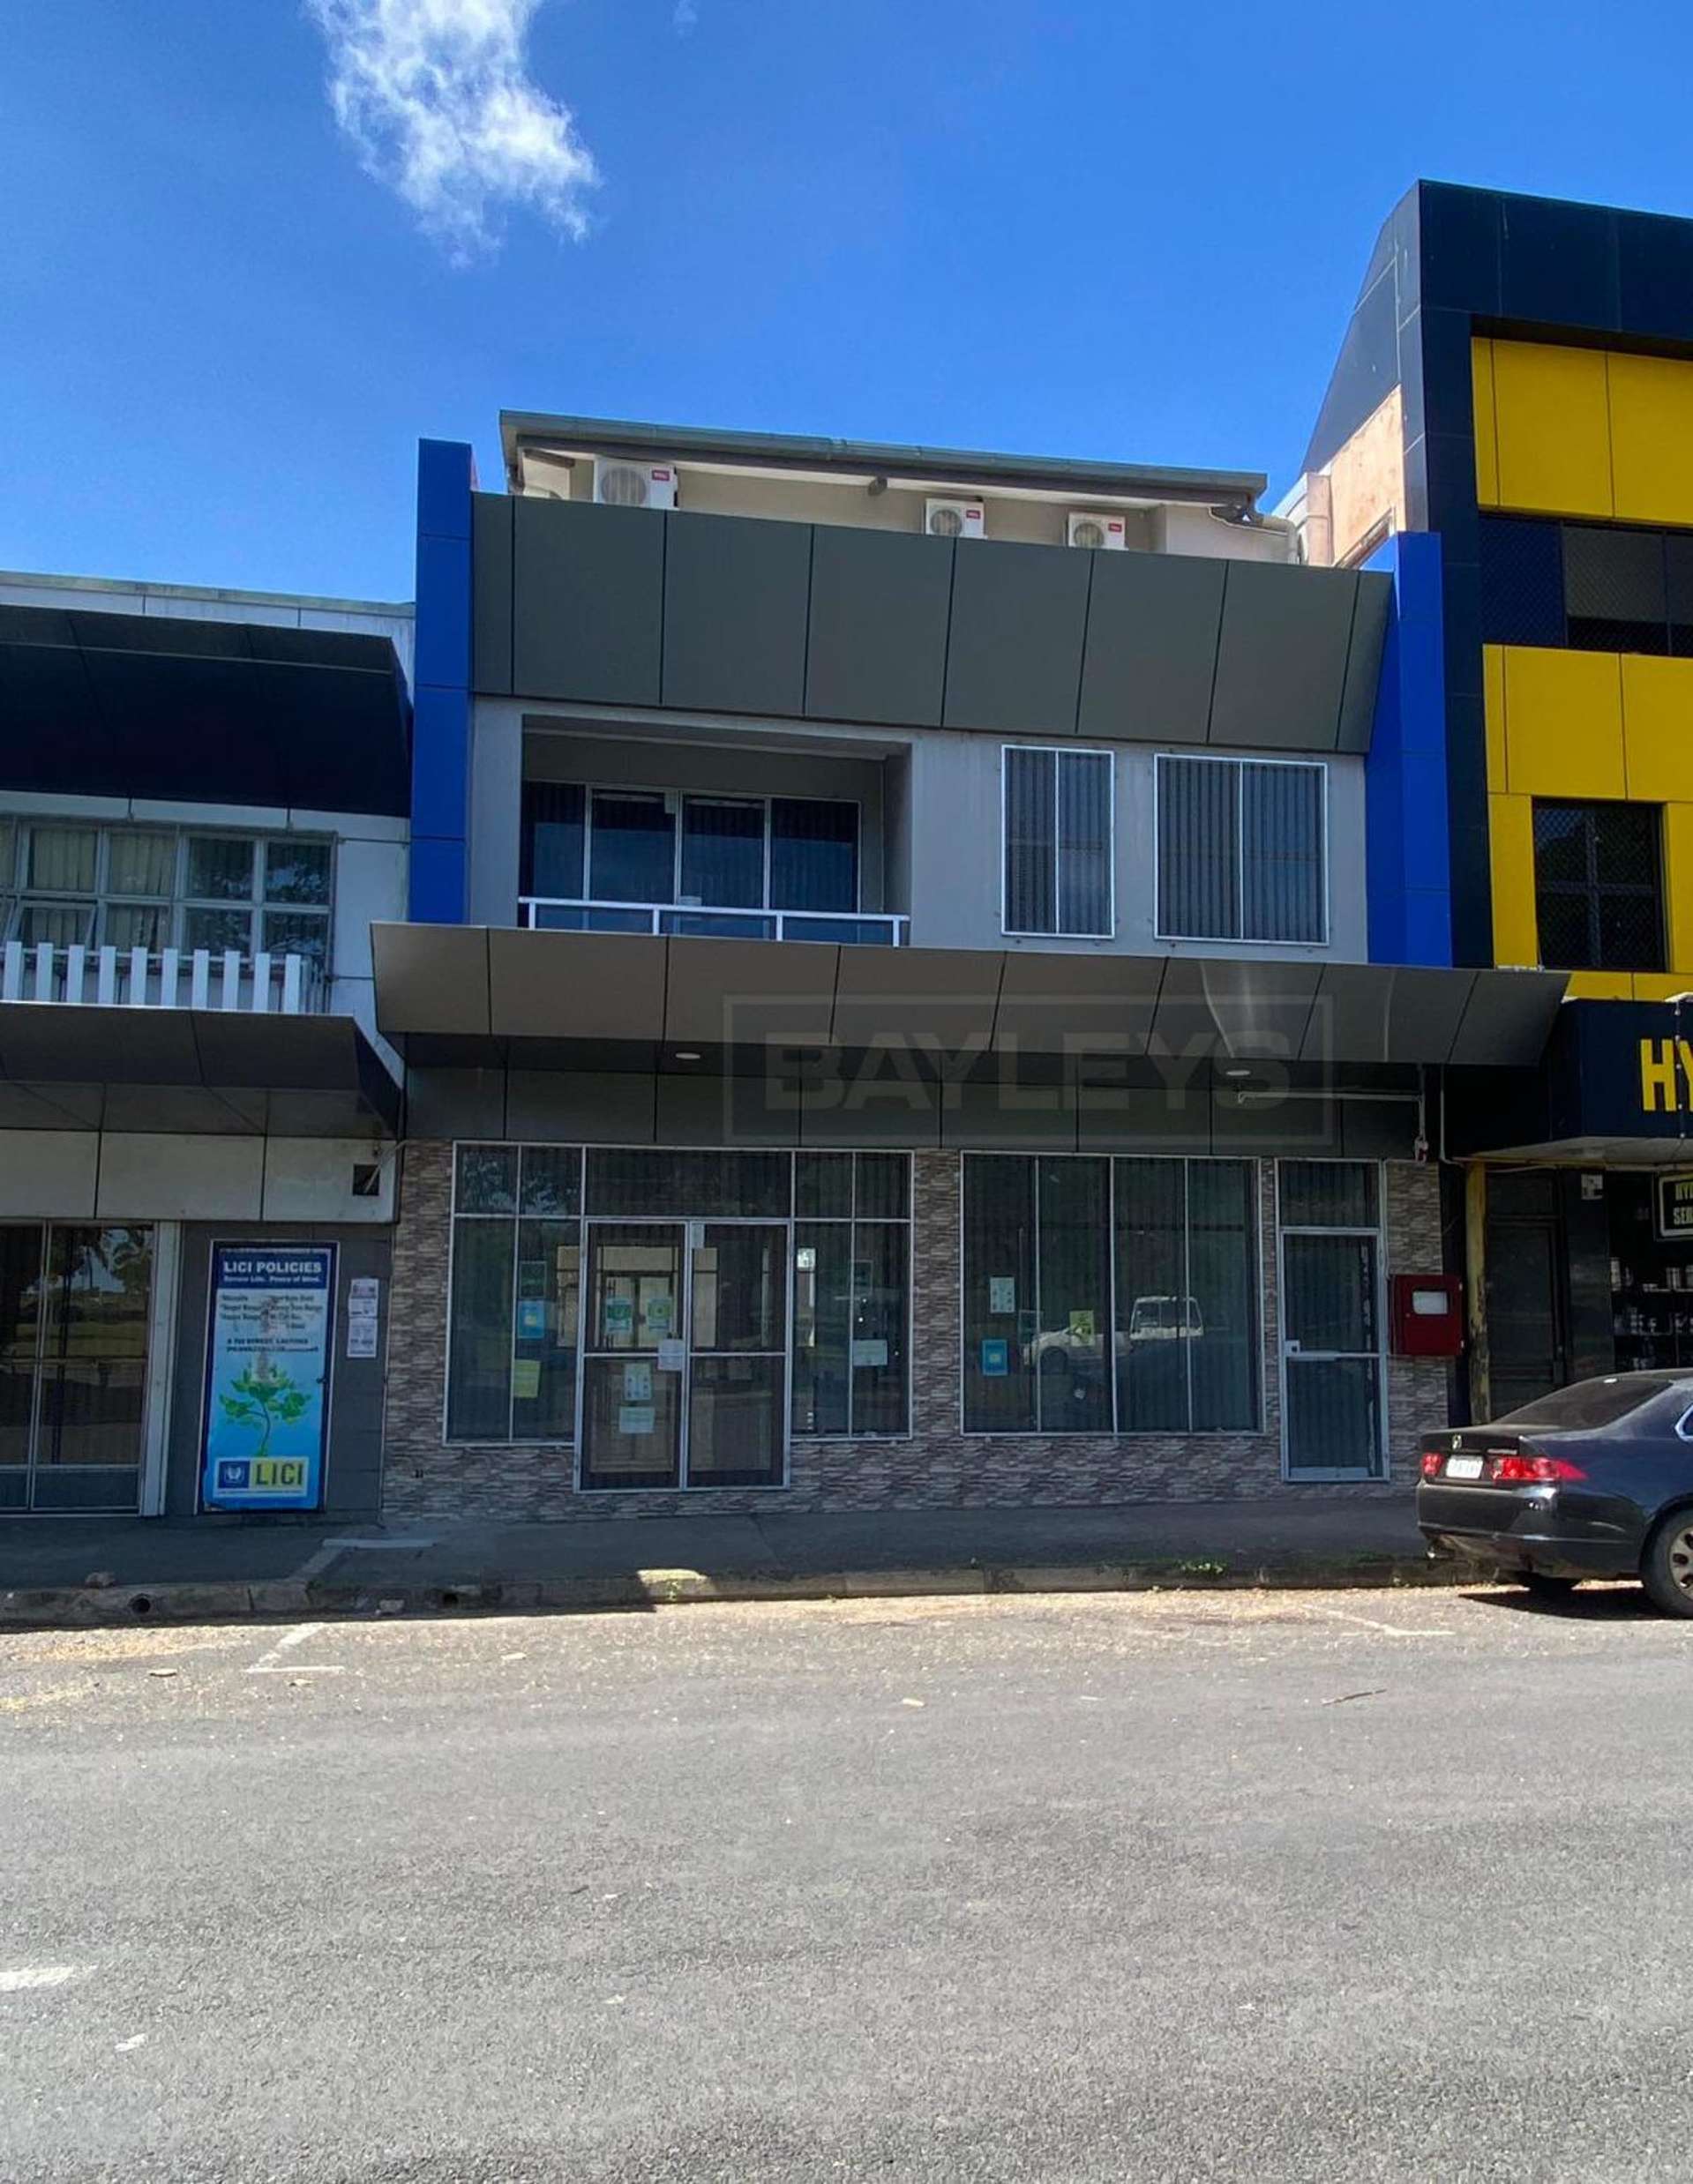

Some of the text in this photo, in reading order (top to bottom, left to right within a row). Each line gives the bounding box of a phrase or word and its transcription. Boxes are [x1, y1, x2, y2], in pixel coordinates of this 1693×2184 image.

[223, 1260, 322, 1273] LICI POLICIES
[255, 1462, 303, 1485] LICI
